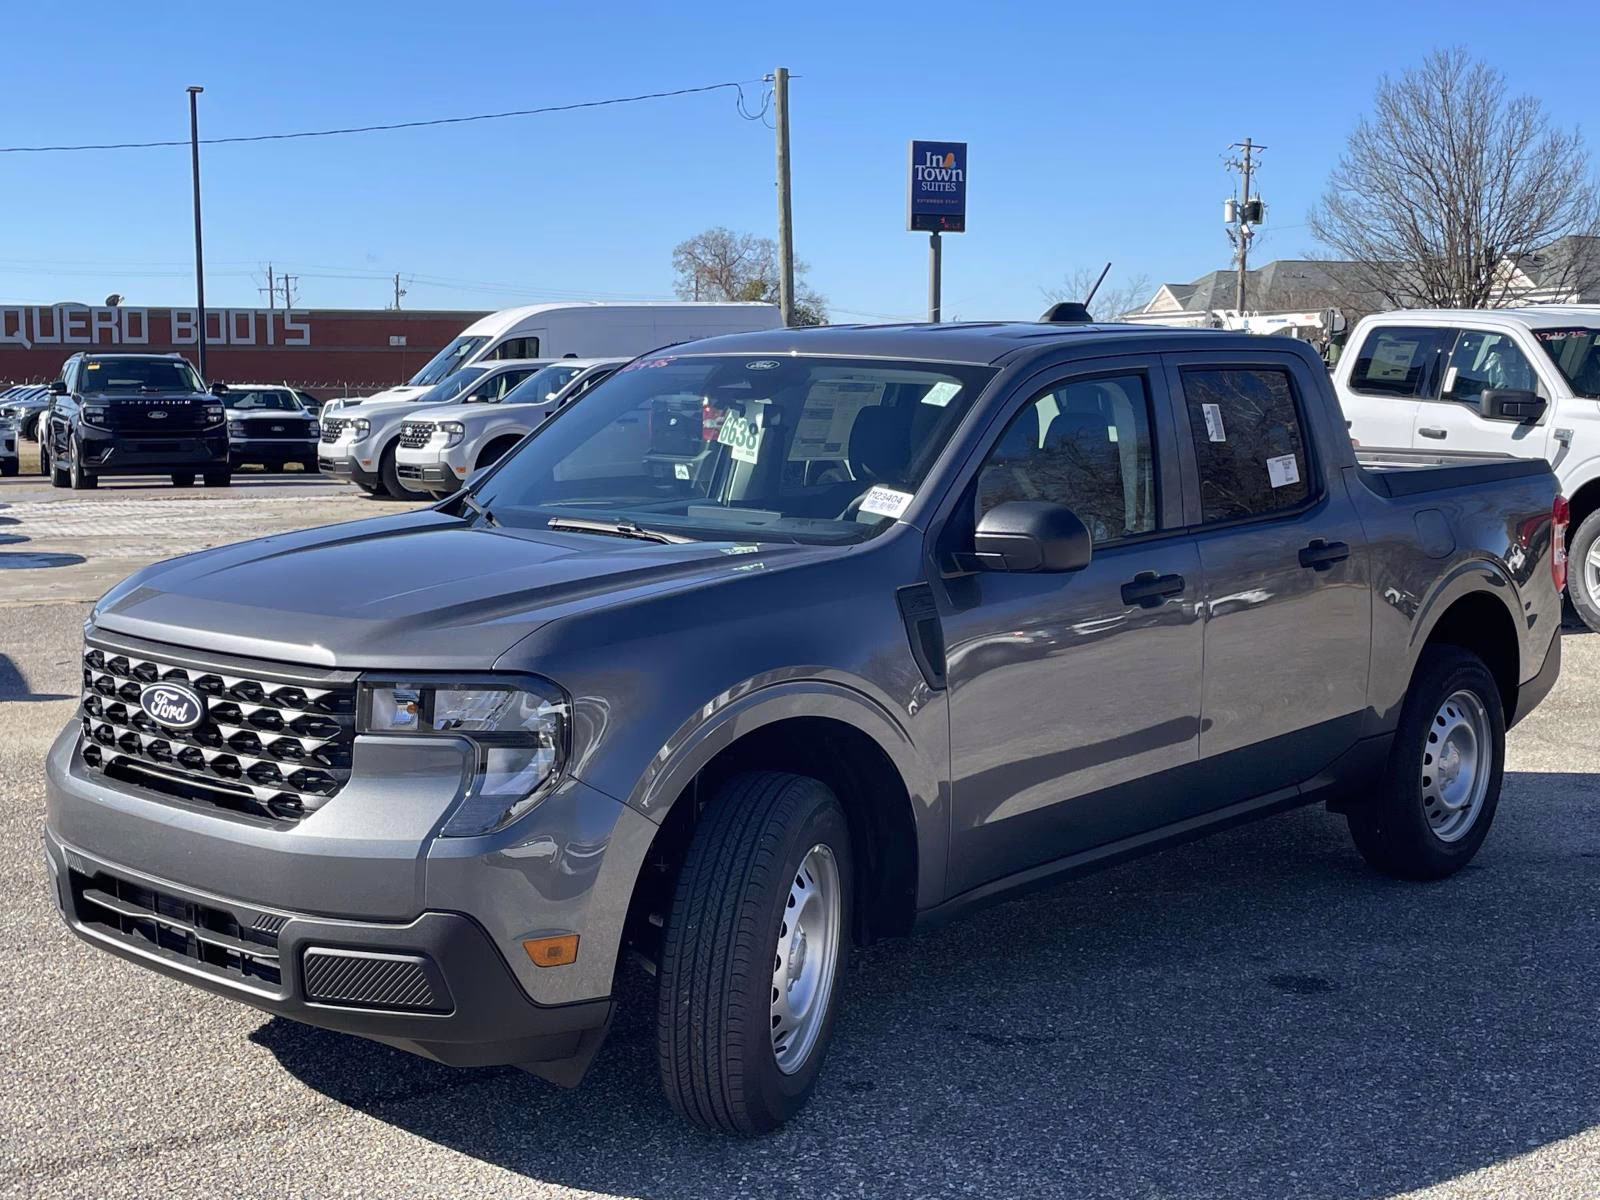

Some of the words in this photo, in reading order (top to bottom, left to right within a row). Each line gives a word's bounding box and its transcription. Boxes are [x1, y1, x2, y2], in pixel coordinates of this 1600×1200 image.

[925, 151, 945, 168] In
[914, 165, 964, 182] Town
[921, 182, 957, 192] SUITES
[0, 306, 149, 350] QUERO
[171, 308, 311, 346] BOOTS
[151, 690, 188, 722] Ford
